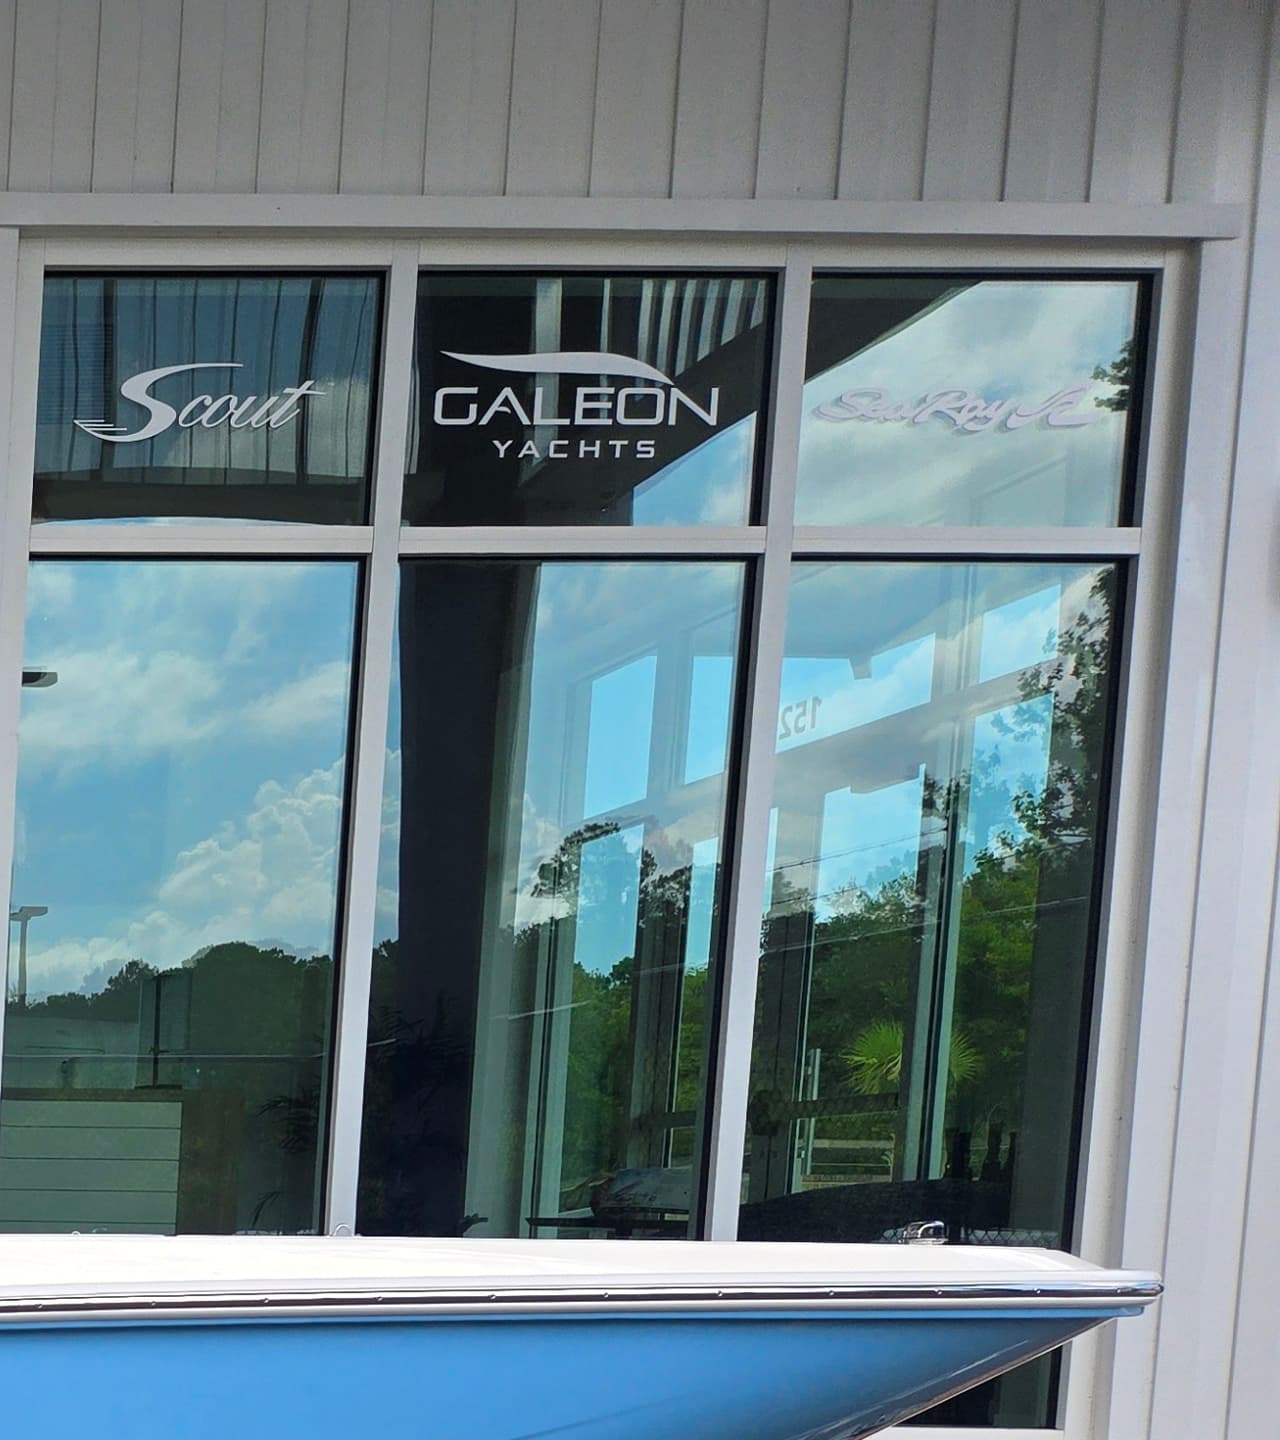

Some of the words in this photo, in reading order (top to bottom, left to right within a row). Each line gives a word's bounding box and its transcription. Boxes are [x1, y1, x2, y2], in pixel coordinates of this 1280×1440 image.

[73, 362, 327, 443] Scout
[433, 386, 720, 426] GALEON
[814, 387, 911, 425] Sea
[912, 389, 1000, 432] Ray
[492, 440, 656, 459] YACHTS
